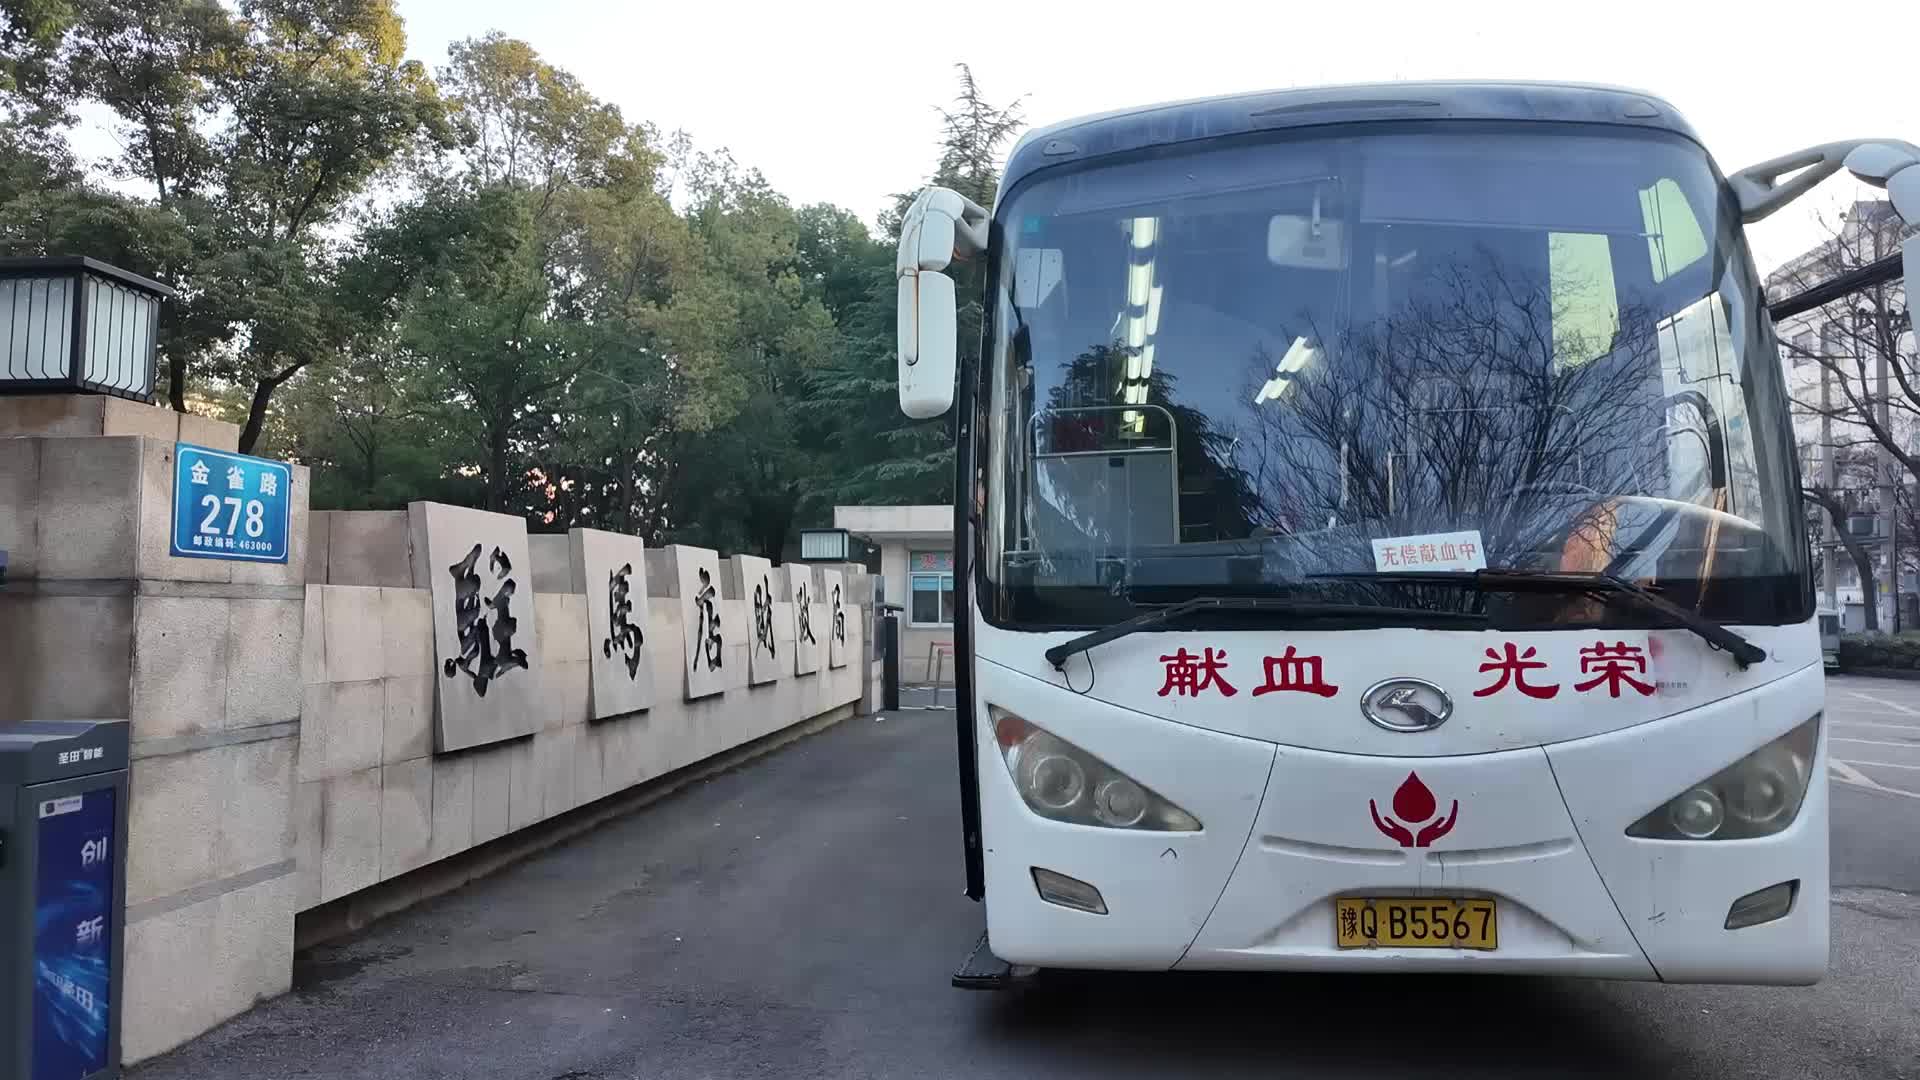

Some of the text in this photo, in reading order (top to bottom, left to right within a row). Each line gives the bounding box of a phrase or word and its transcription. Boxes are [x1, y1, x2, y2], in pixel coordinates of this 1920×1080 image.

[190, 459, 278, 497] 金雀路
[200, 494, 265, 538] 278
[1381, 540, 1477, 567] 无偿献血中
[1157, 641, 1657, 700] 献血 光荣
